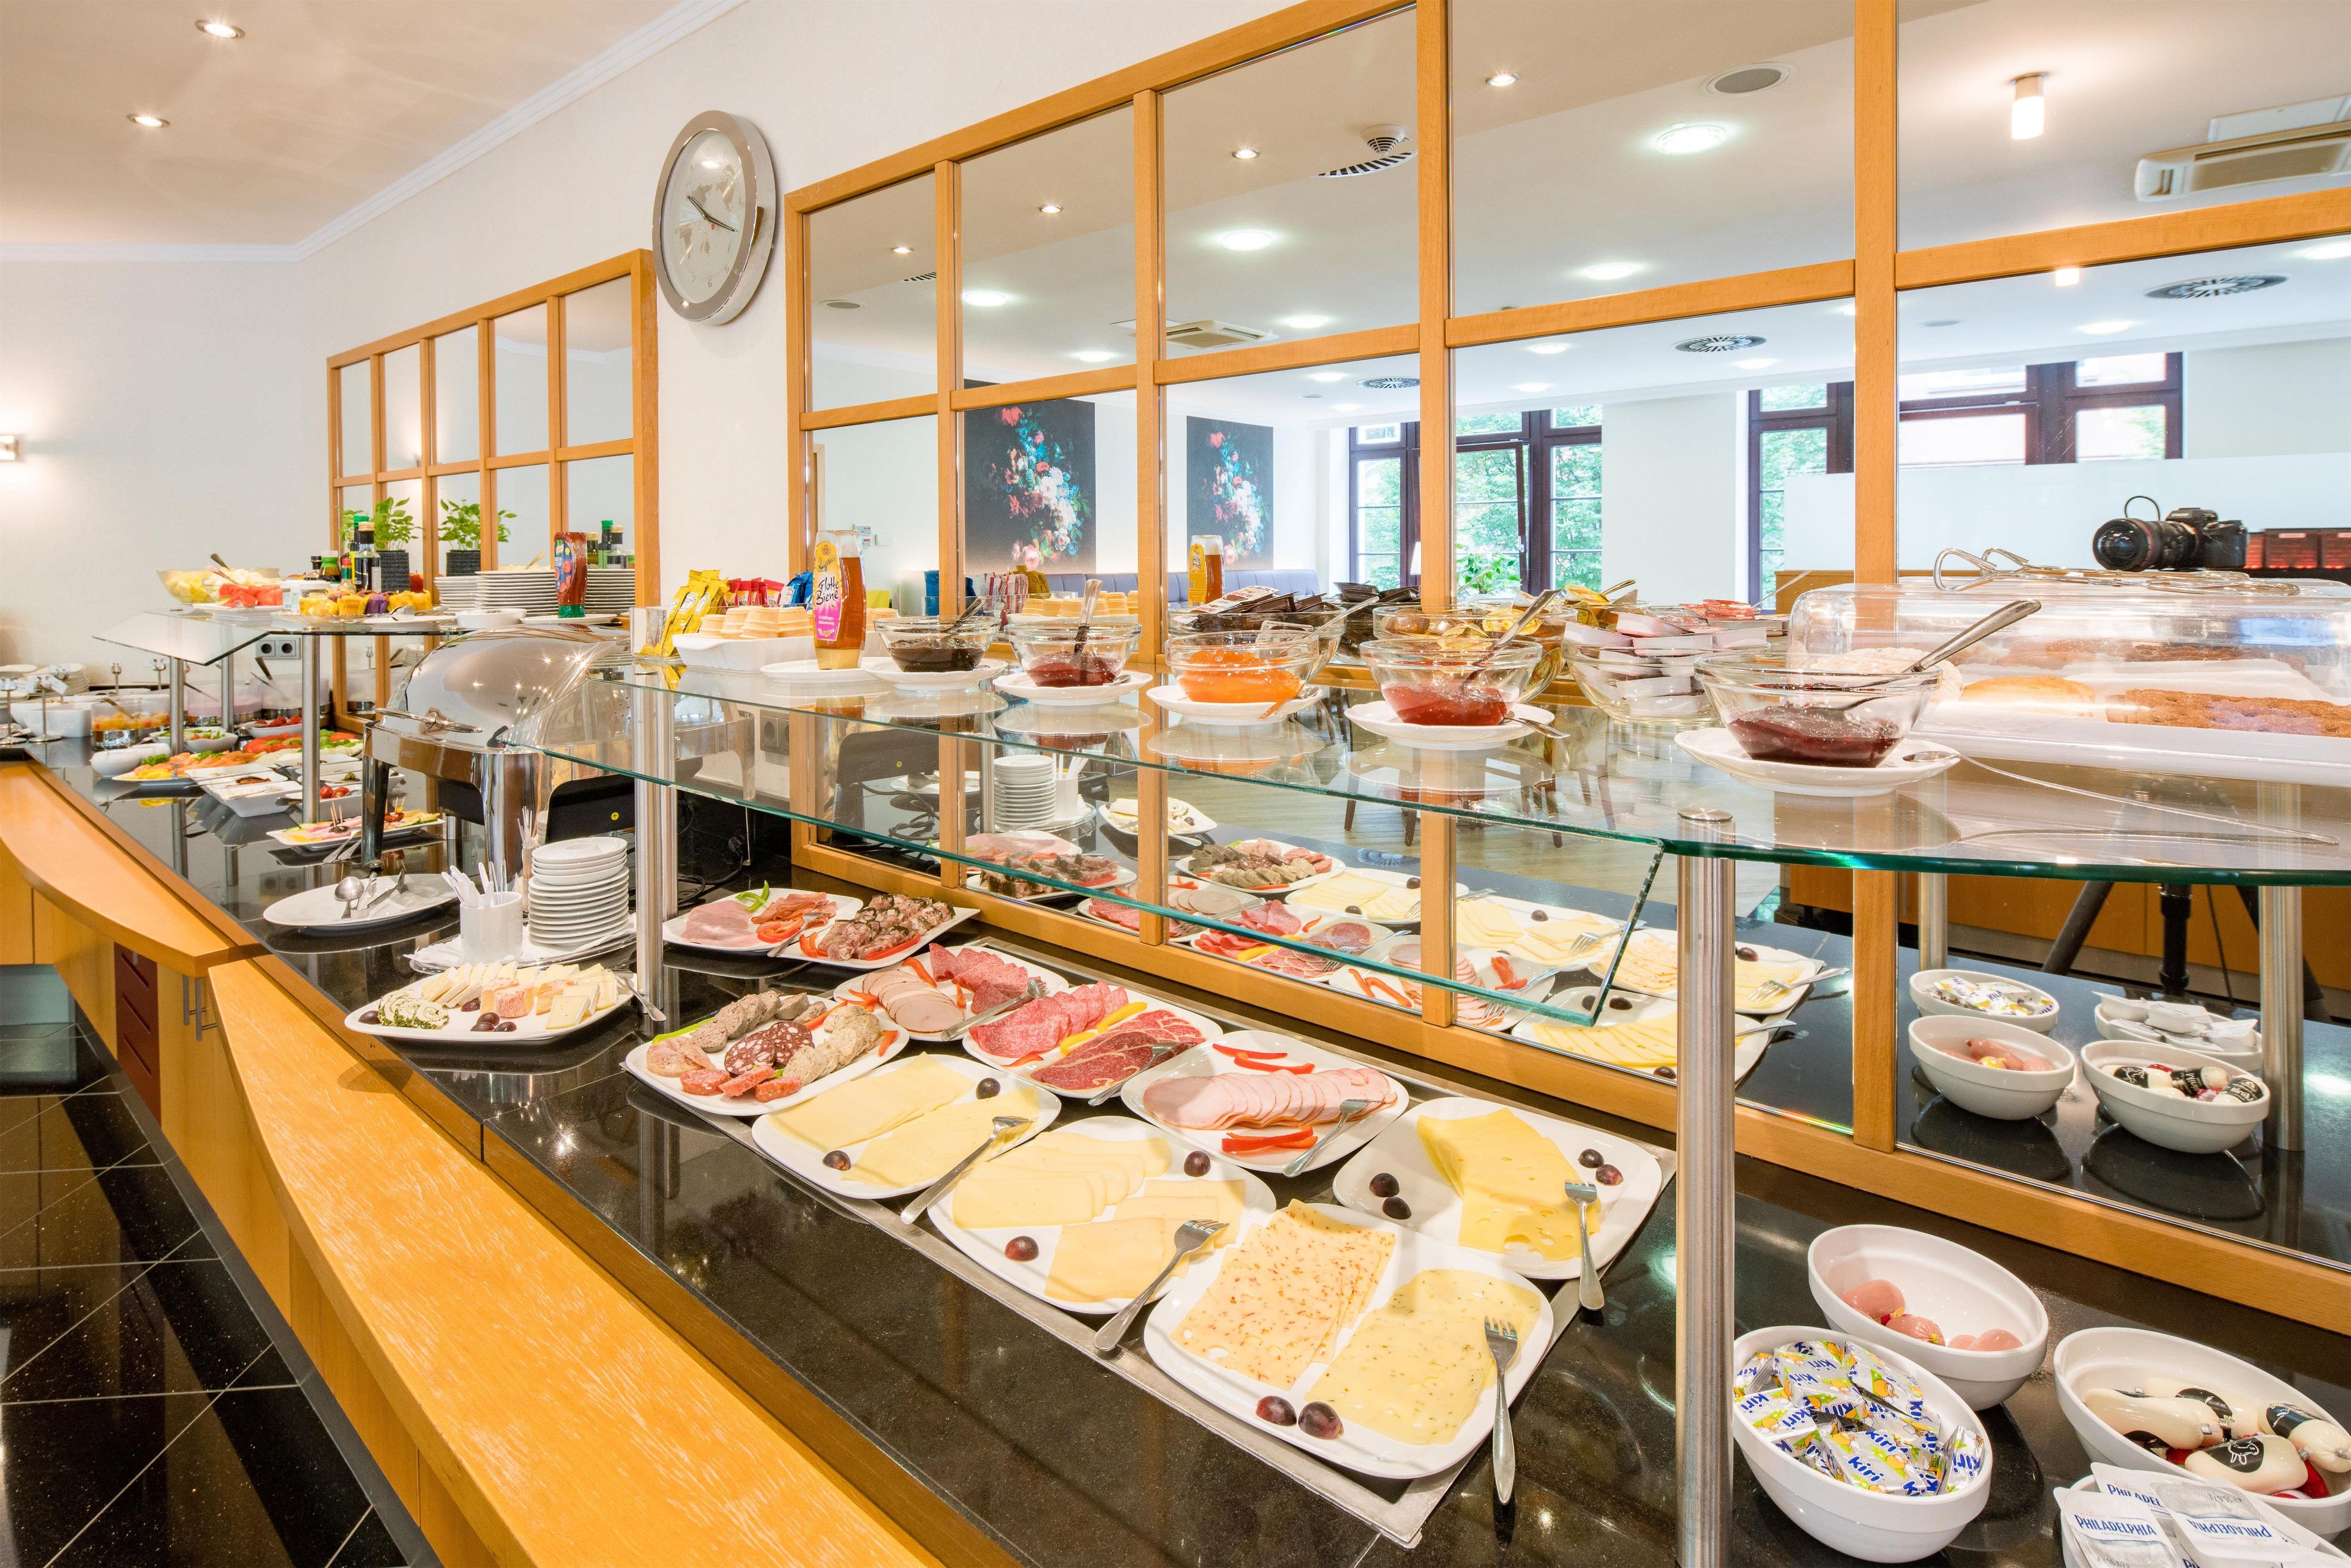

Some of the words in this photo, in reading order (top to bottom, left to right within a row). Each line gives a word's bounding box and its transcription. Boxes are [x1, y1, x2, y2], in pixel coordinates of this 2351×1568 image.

[691, 274, 696, 283] 7
[724, 263, 730, 274] 5
[708, 278, 713, 288] 6
[818, 576, 839, 592] Flotte
[816, 590, 839, 606] Biene
[1789, 1373, 1820, 1387] kiri
[1740, 1393, 1770, 1414] kiri
[1782, 1408, 1813, 1430] kiri
[1864, 1430, 1899, 1454] kiri
[1847, 1455, 1885, 1483] kiri
[2106, 1483, 2164, 1509] PHILADEL
[2074, 1514, 2158, 1536] PHILADELPHIA
[2186, 1518, 2274, 1539] PHILADELPHIA
